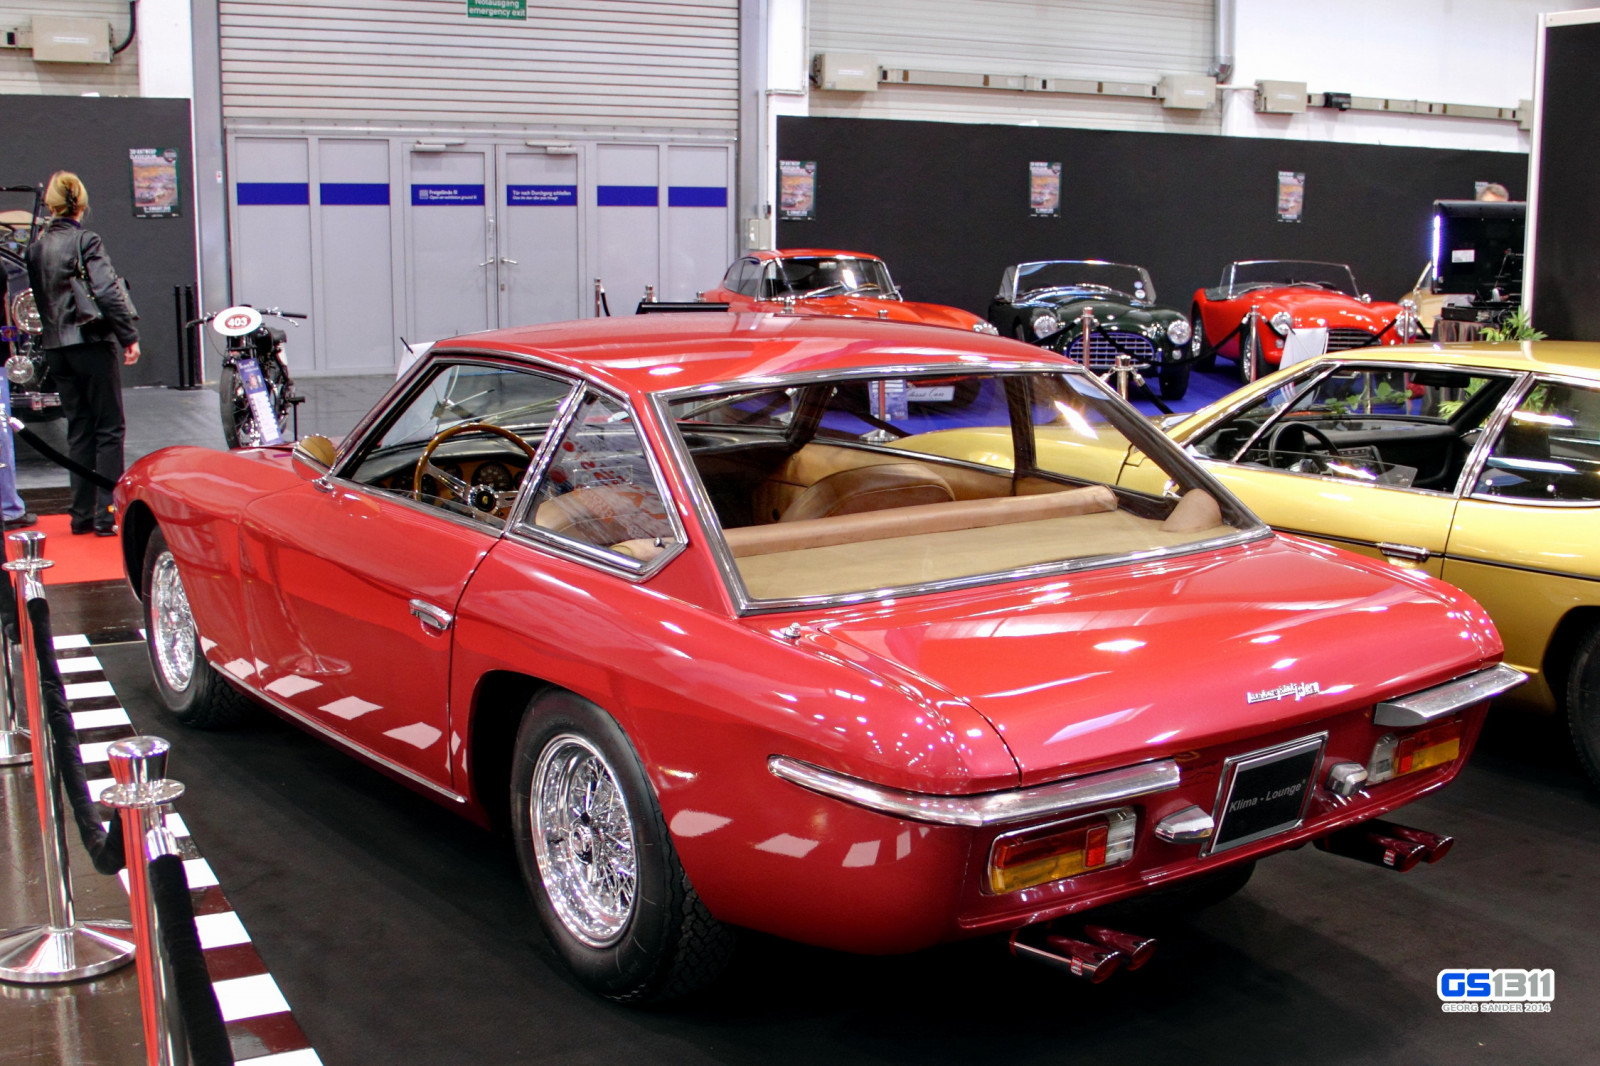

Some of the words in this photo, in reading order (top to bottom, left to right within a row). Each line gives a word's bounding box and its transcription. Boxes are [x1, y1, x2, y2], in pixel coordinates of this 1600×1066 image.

[469, 8, 510, 17] emergency
[511, 9, 525, 17] exit
[1228, 797, 1259, 813] Klima
